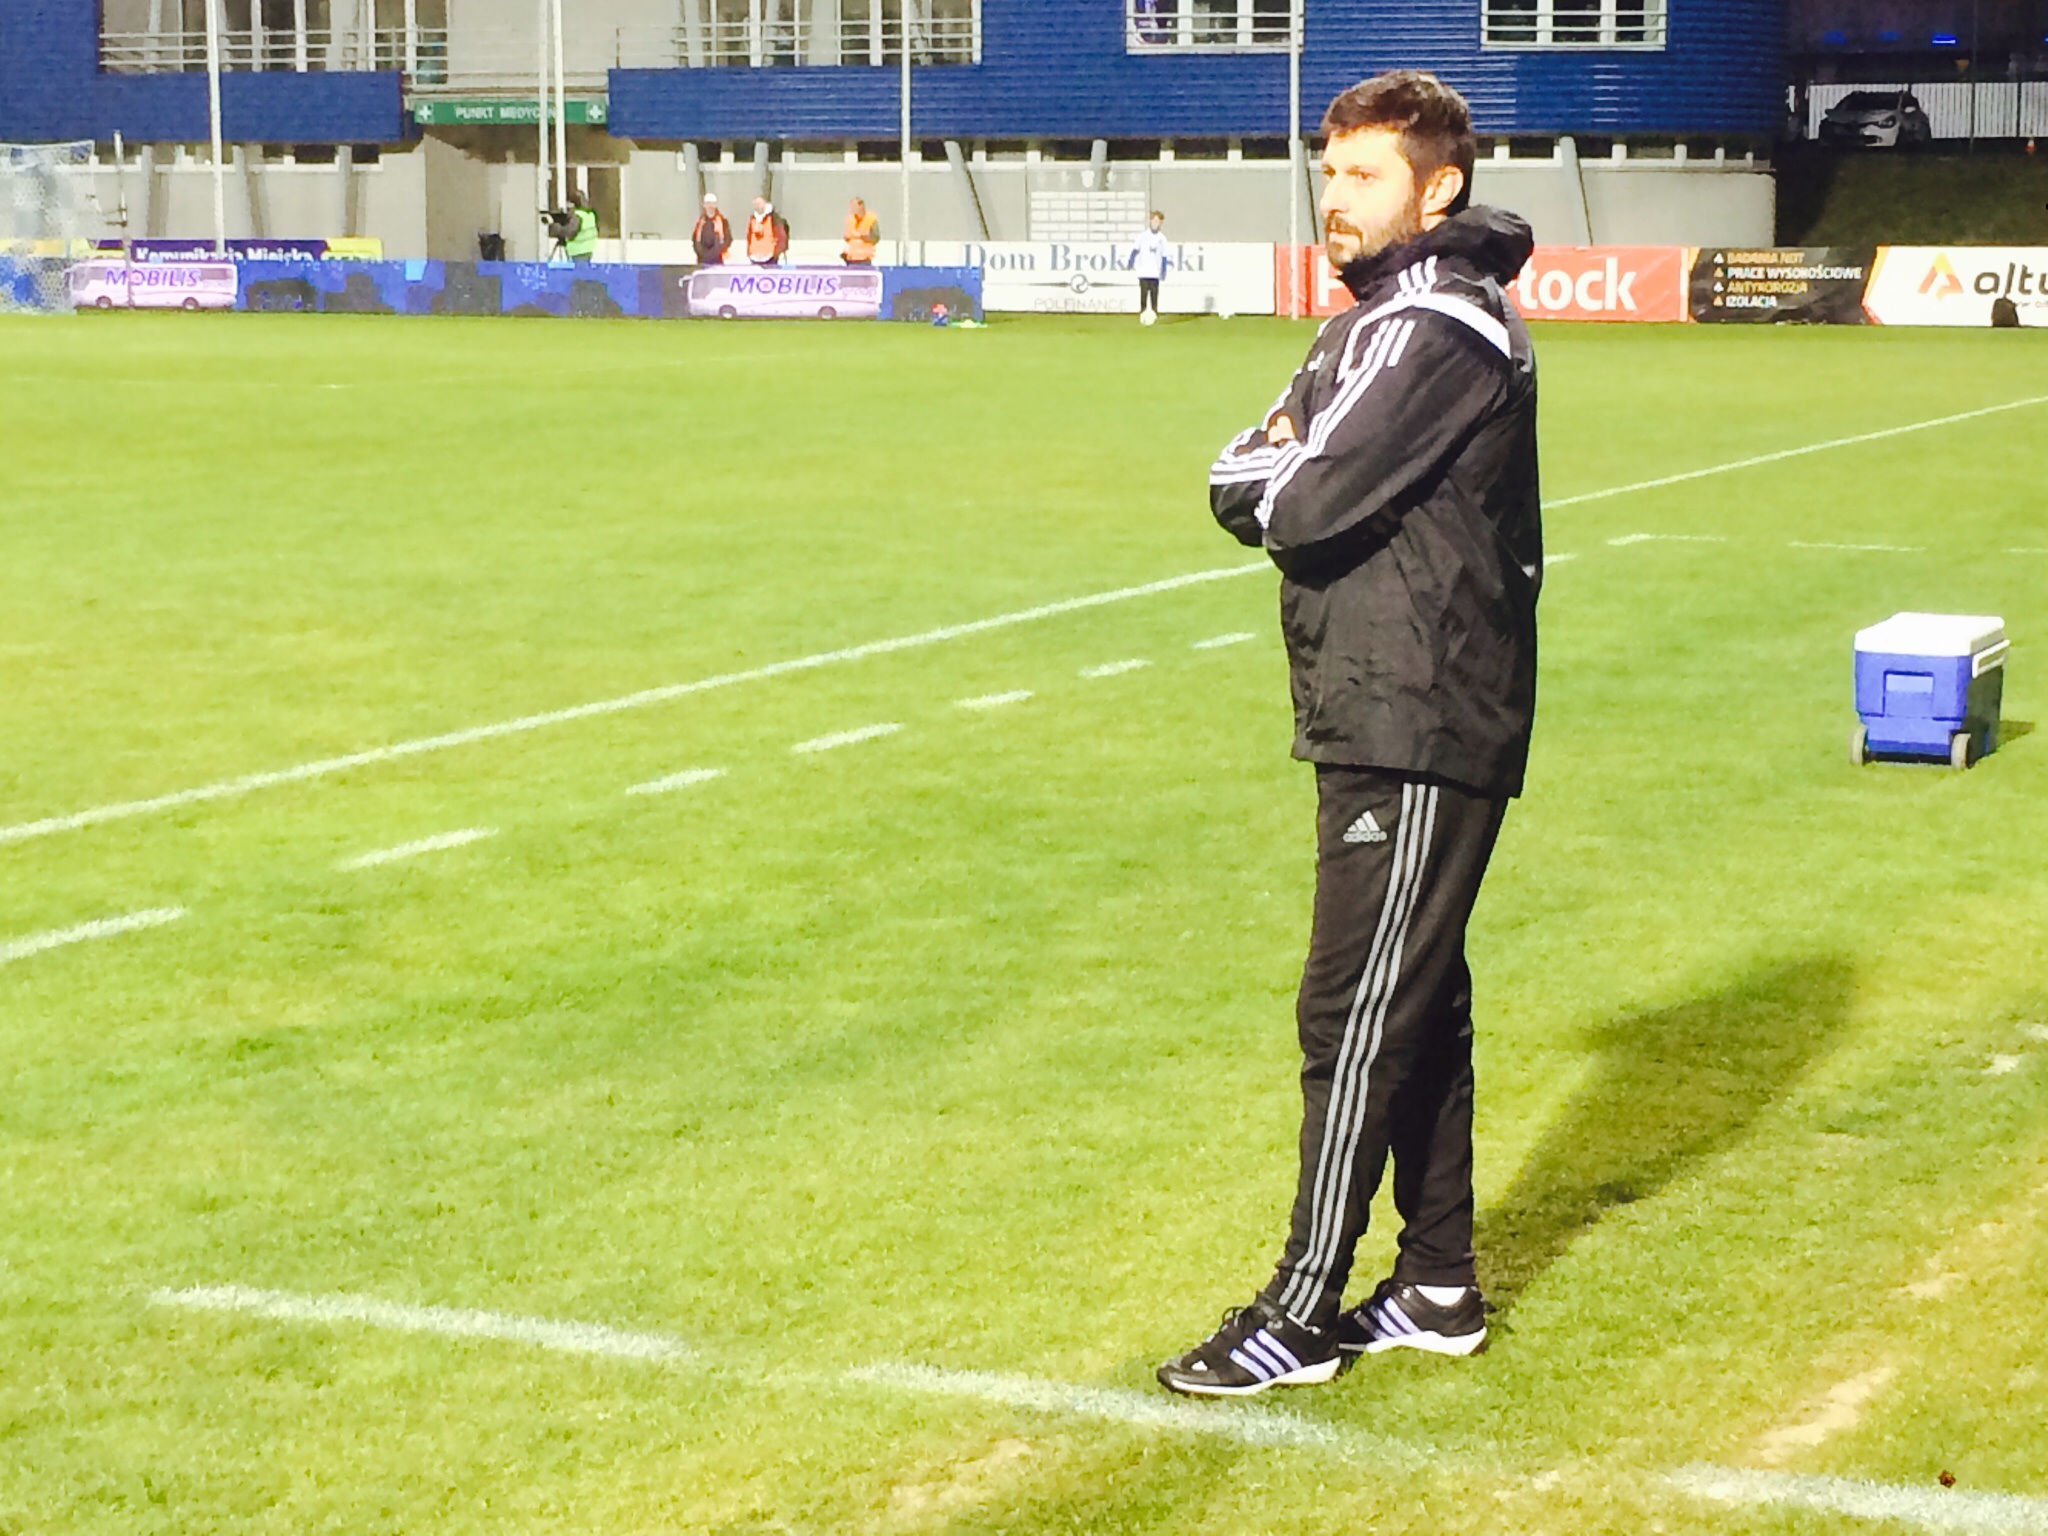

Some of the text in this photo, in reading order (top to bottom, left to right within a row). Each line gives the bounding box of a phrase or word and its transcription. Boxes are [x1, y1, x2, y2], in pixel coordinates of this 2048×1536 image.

[455, 107, 494, 119] PUNKT
[964, 244, 1035, 272] Dom
[1049, 244, 1205, 272] Brokski
[105, 269, 200, 287] MOBILIS
[1727, 267, 1765, 279] PRACE
[729, 276, 839, 296] MOBILIS
[1725, 295, 1778, 308] IZOLACJA
